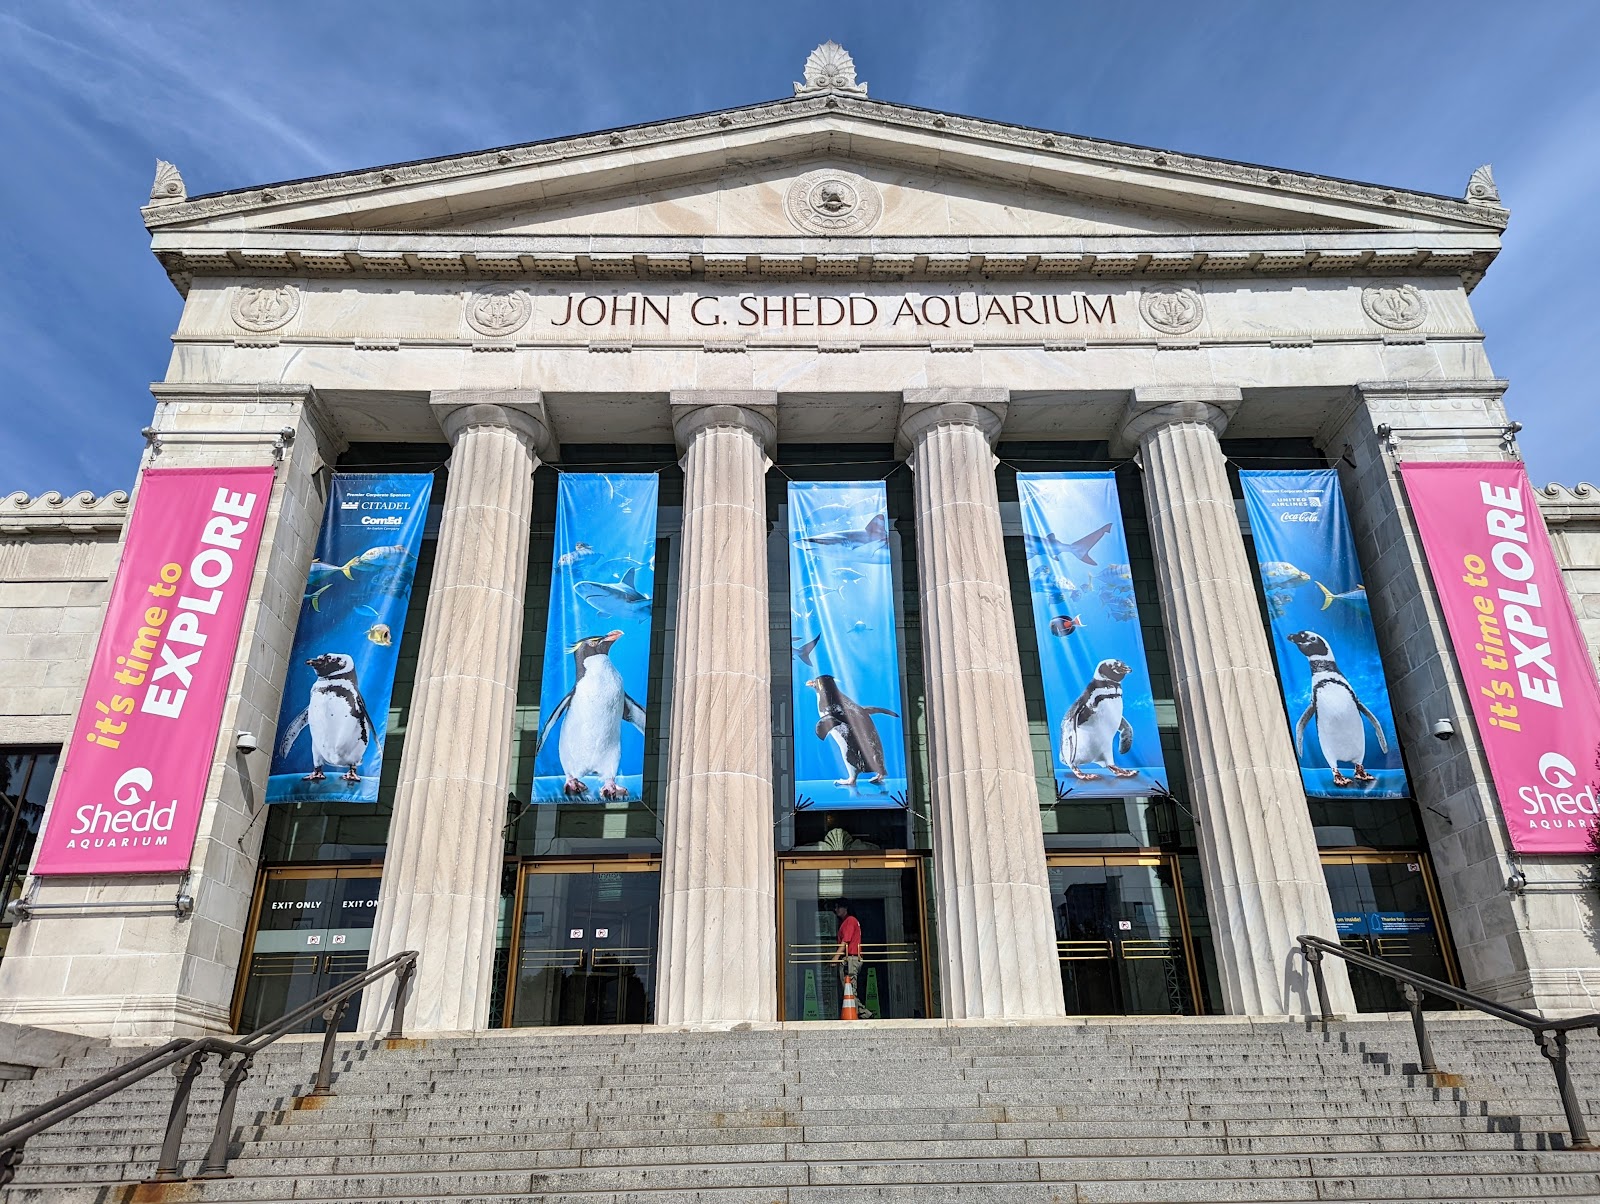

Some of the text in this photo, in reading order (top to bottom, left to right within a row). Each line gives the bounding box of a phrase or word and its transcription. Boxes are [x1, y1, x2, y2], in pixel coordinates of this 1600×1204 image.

[550, 295, 1117, 328] JOHN G. SHEDD AQUARIUM
[361, 501, 411, 510] CITADEL
[361, 516, 404, 525] ComEd
[141, 487, 258, 719] EXPLORE
[1479, 480, 1564, 709] EXPLORE
[86, 561, 182, 750] it's time to
[1462, 553, 1522, 732] it's time to
[1518, 785, 1600, 814] Shed
[70, 800, 177, 834] Shedd
[1529, 819, 1596, 829] AQUARI
[66, 836, 168, 850] AQUARIUM
[296, 901, 322, 909] ONLY
